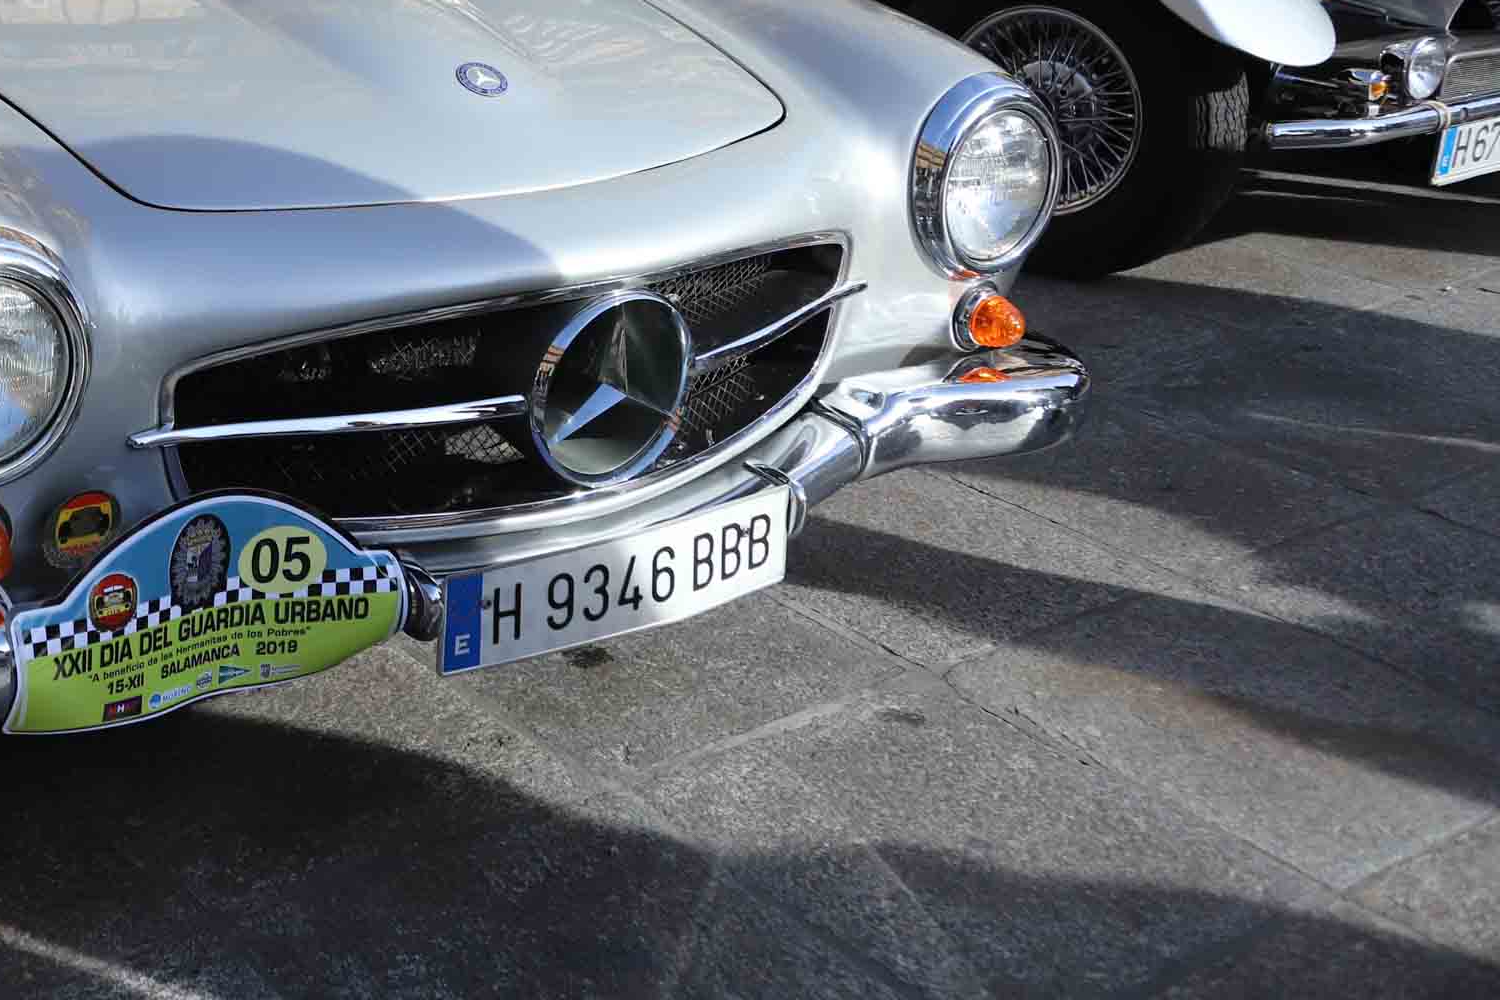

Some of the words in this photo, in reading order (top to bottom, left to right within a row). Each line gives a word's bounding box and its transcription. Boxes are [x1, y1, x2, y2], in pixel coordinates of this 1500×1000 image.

[251, 535, 311, 583] 05
[491, 581, 522, 645] H
[546, 545, 677, 631] 9346
[692, 512, 773, 593] BBB
[52, 647, 93, 681] XXII
[99, 637, 133, 668] DIA
[139, 623, 173, 656] DEL
[178, 601, 266, 642] GUARDIA
[273, 596, 370, 625] URBANO
[147, 657, 158, 667] de
[230, 629, 244, 640] de
[453, 633, 472, 657] E
[160, 642, 240, 680] SALAMANCA
[107, 671, 145, 696] 15-XII
